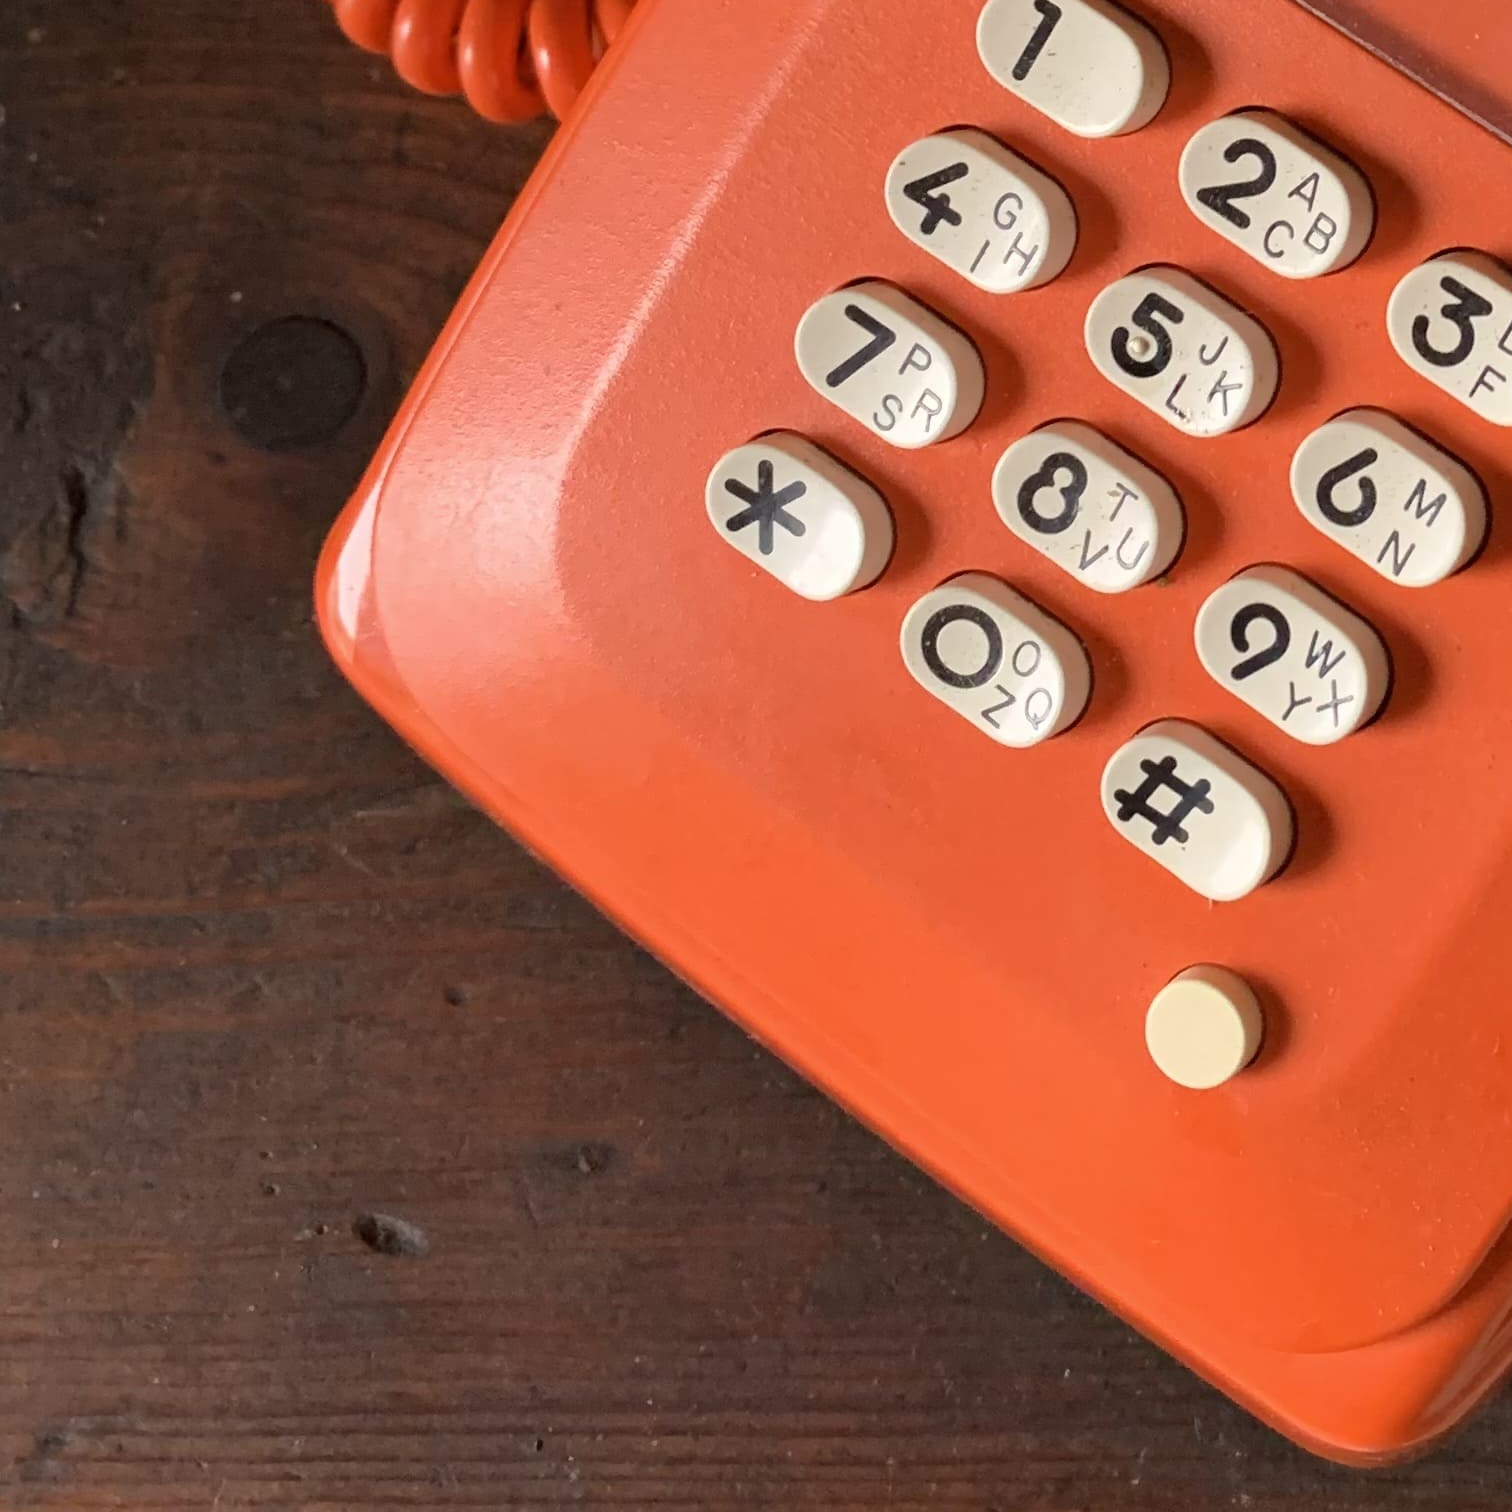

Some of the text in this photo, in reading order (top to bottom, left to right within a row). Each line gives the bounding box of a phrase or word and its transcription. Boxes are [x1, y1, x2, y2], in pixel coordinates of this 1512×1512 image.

[903, 163, 968, 235] 4
[994, 193, 1022, 230] G
[1197, 139, 1336, 258] 2 A B C
[1004, 232, 1038, 276] H
[826, 305, 942, 432] 7 P R S
[1111, 293, 1183, 378] 5
[1199, 336, 1228, 365] J
[1412, 276, 1492, 367] 3
[1469, 365, 1506, 397] F
[1207, 370, 1242, 416] K
[1017, 452, 1149, 570] 8 T U V
[1316, 448, 1446, 576] 6 M N
[921, 605, 1002, 688] 0
[1231, 603, 1353, 726] 9 W X Y
[981, 684, 1015, 728] Z
[1024, 689, 1054, 731] Q
